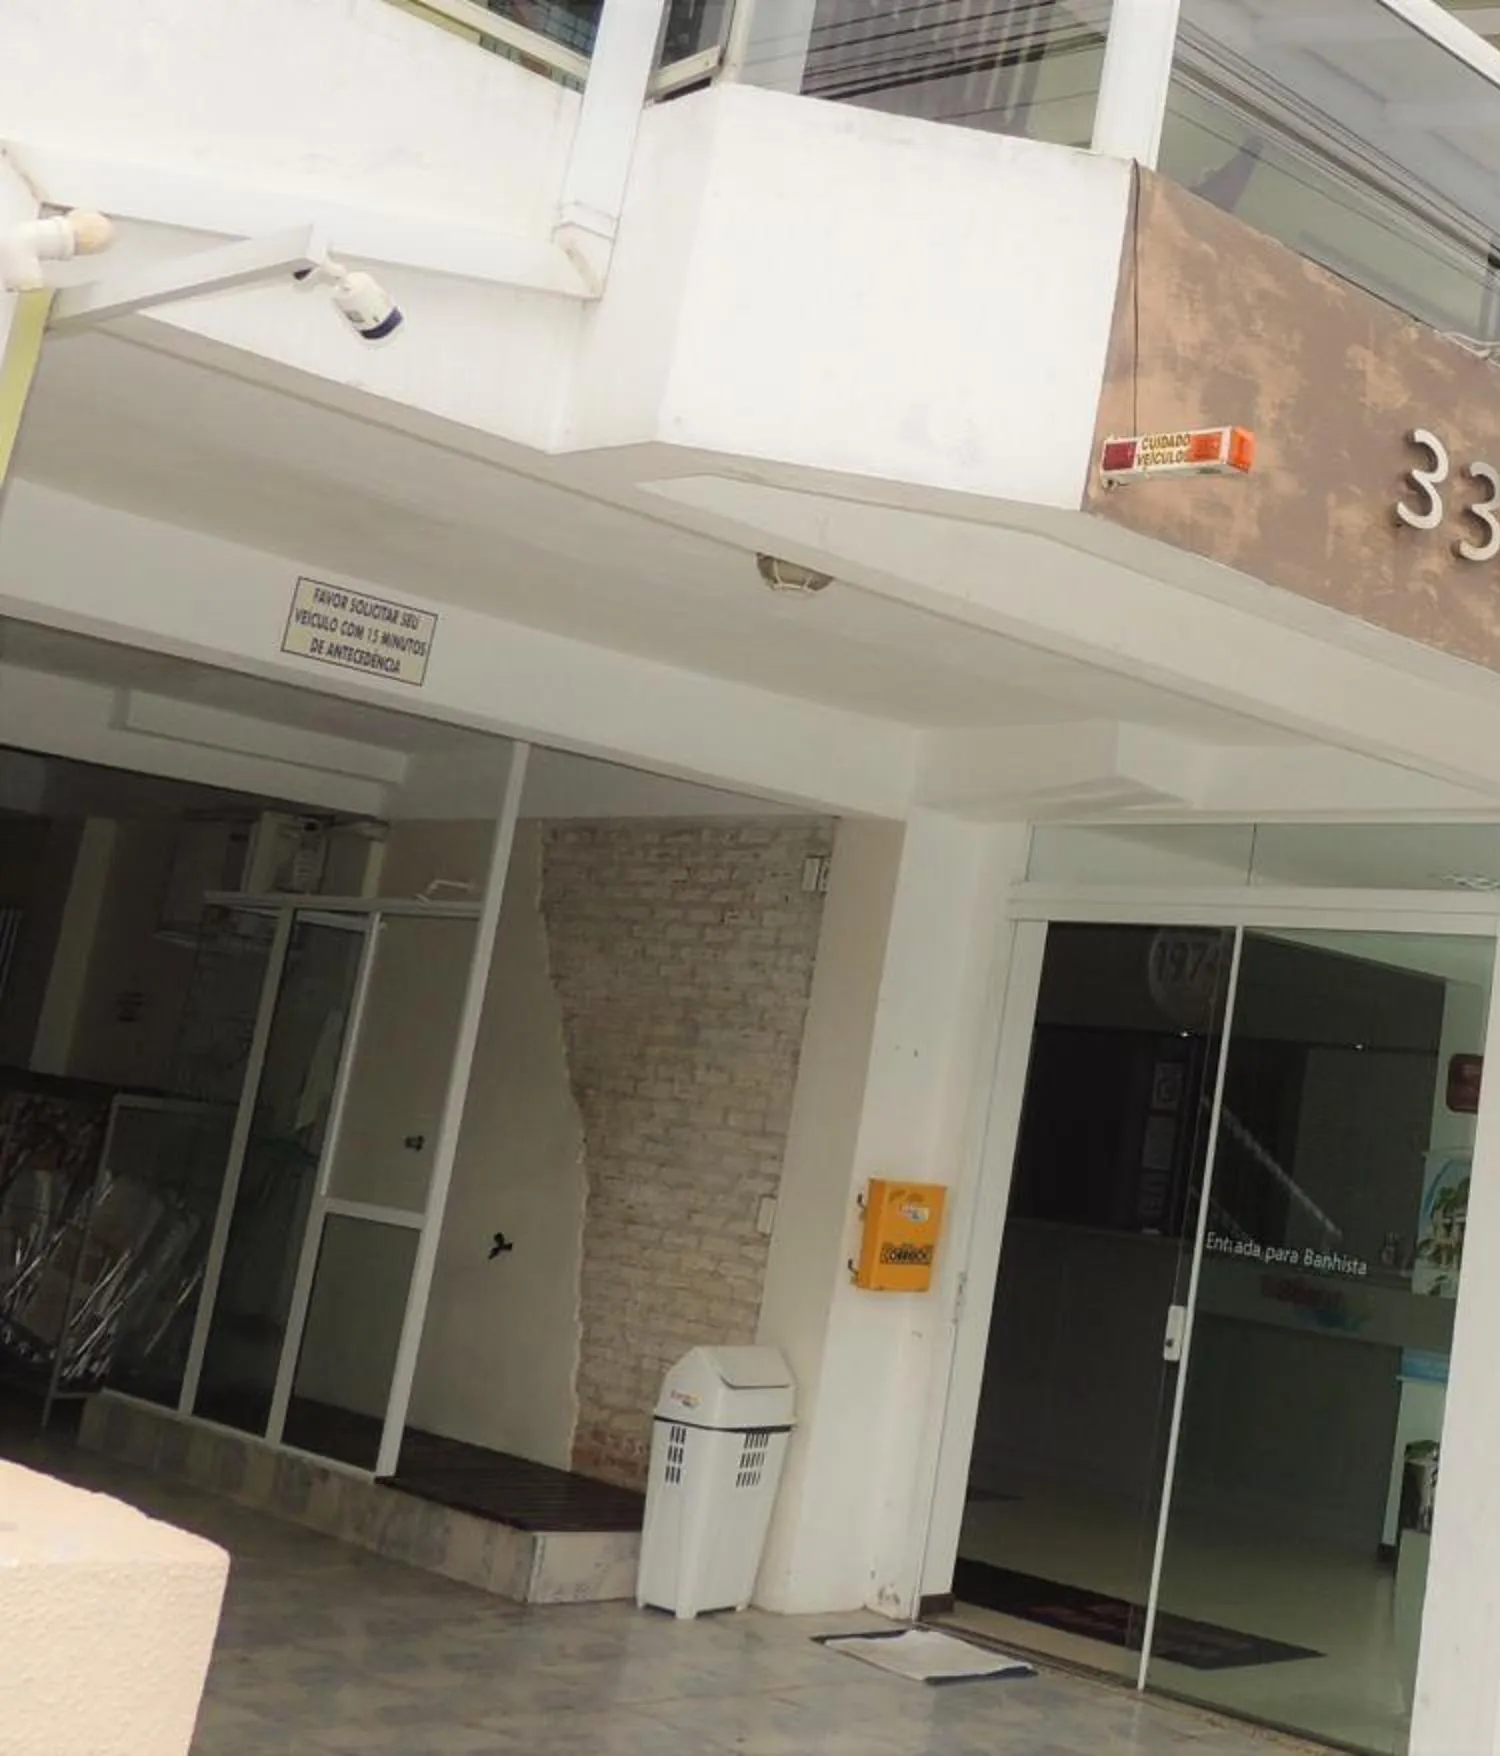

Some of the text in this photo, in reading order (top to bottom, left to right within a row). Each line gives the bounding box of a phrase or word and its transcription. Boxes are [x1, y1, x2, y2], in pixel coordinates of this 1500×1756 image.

[1141, 433, 1191, 450] CUIDADO
[313, 588, 419, 630] FAVOR SOLICITAR SEU
[310, 637, 324, 654] DE
[340, 620, 364, 640] COM
[367, 627, 380, 644] 15
[380, 632, 427, 657] MINUTOS
[1206, 1231, 1368, 1275] Entrada para Banhista
